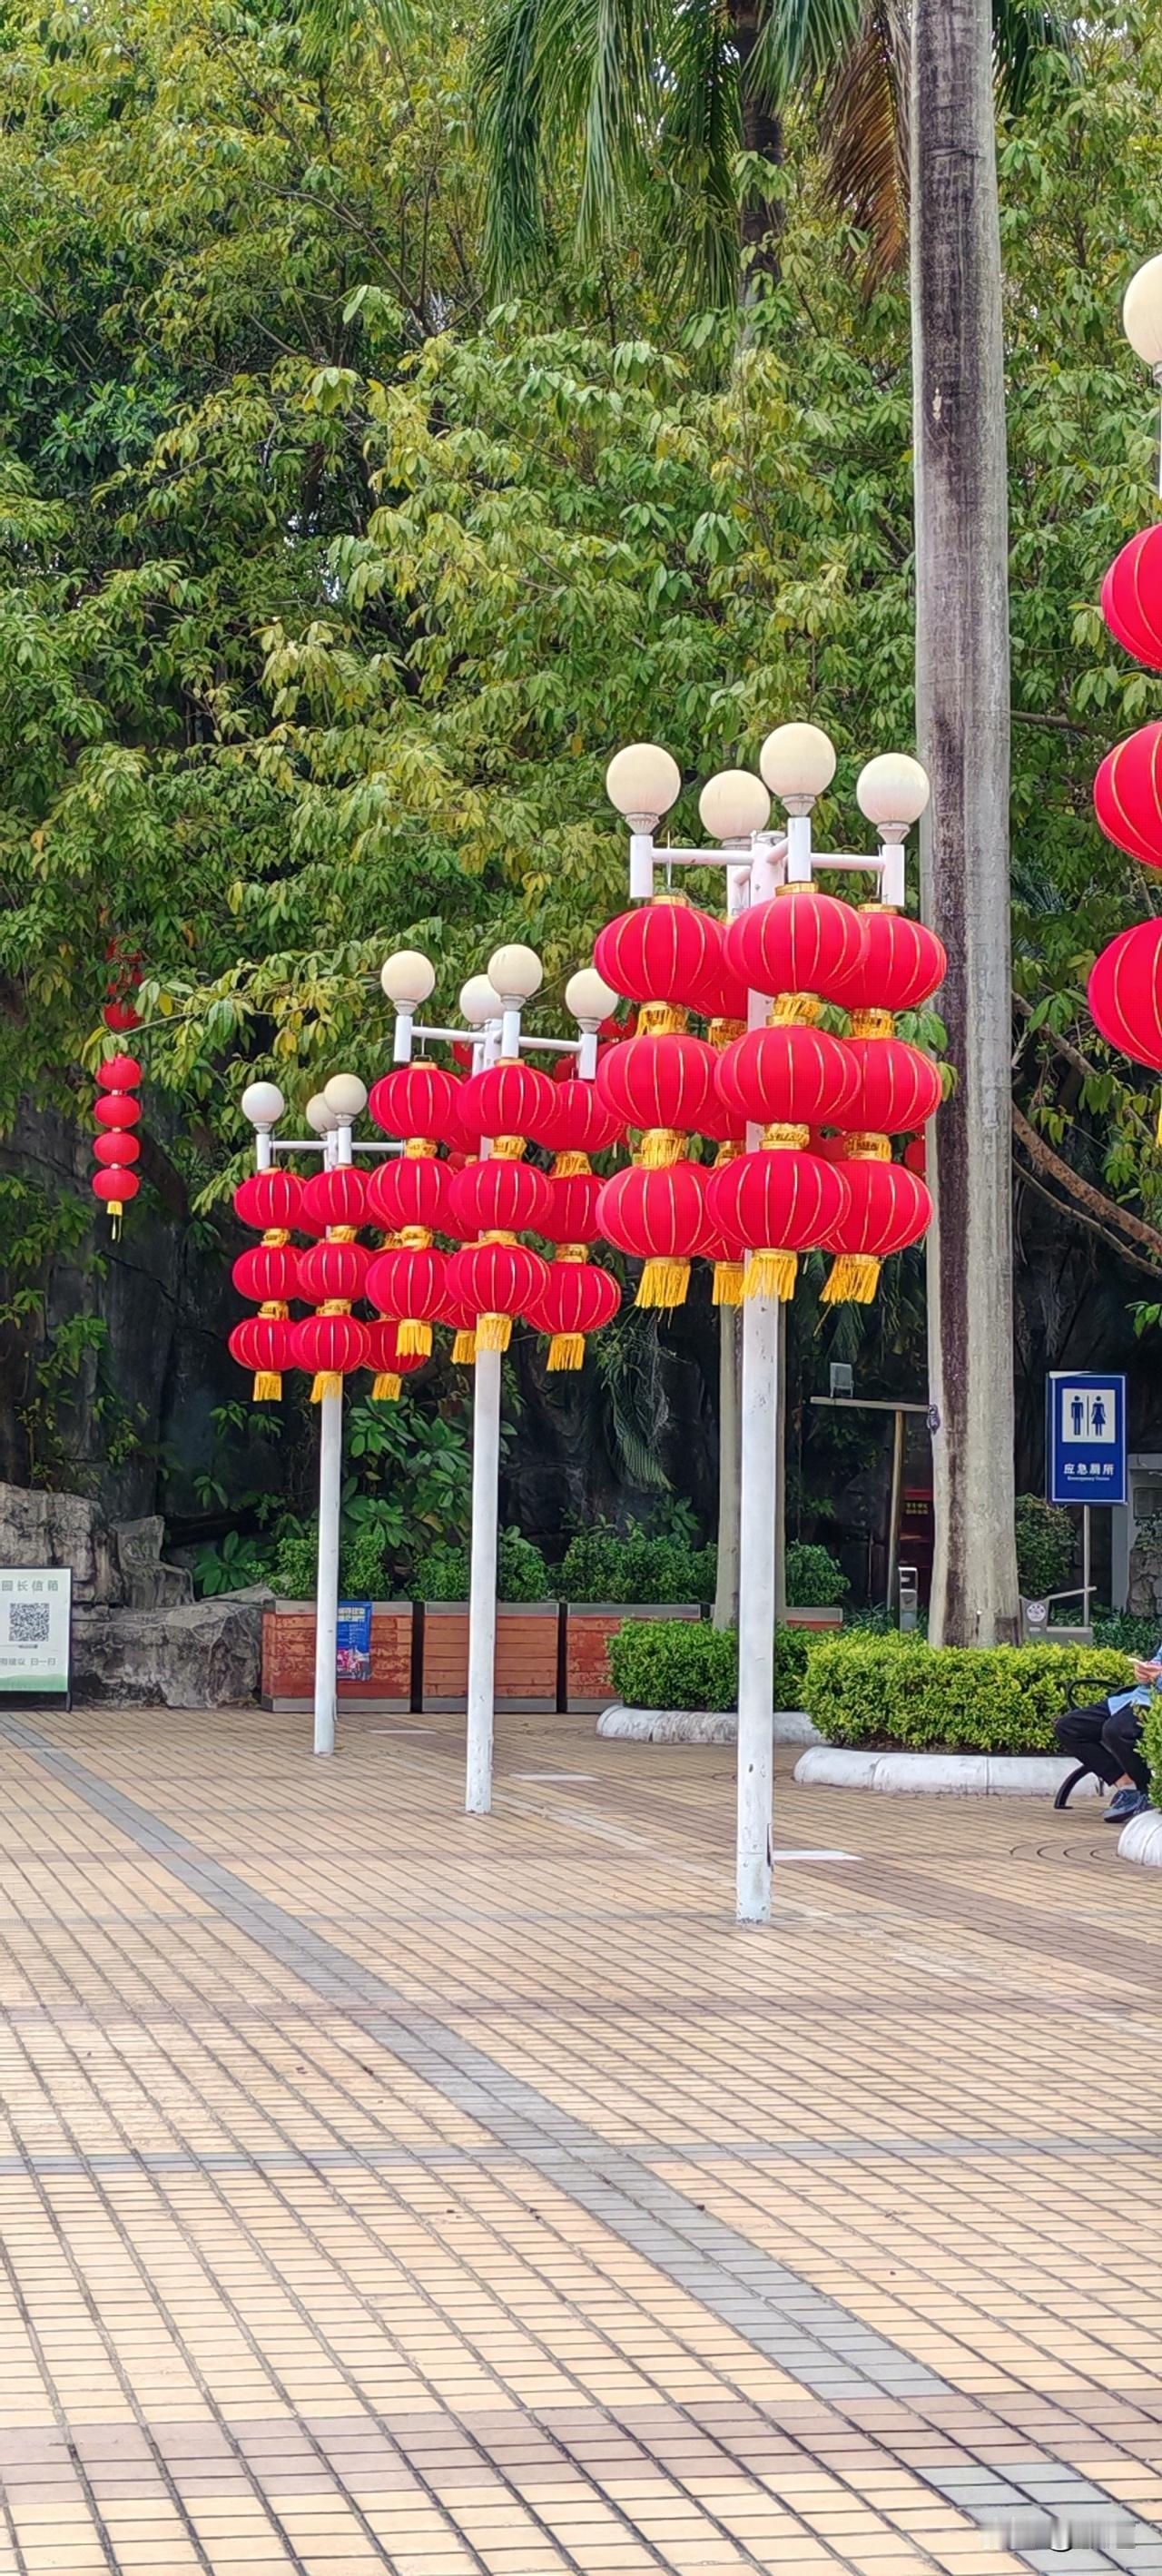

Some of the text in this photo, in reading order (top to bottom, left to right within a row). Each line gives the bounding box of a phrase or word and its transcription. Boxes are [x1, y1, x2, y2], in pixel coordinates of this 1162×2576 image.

[1064, 1463, 1114, 1476] 应急厕所
[1, 1580, 59, 1592] 园长信箱
